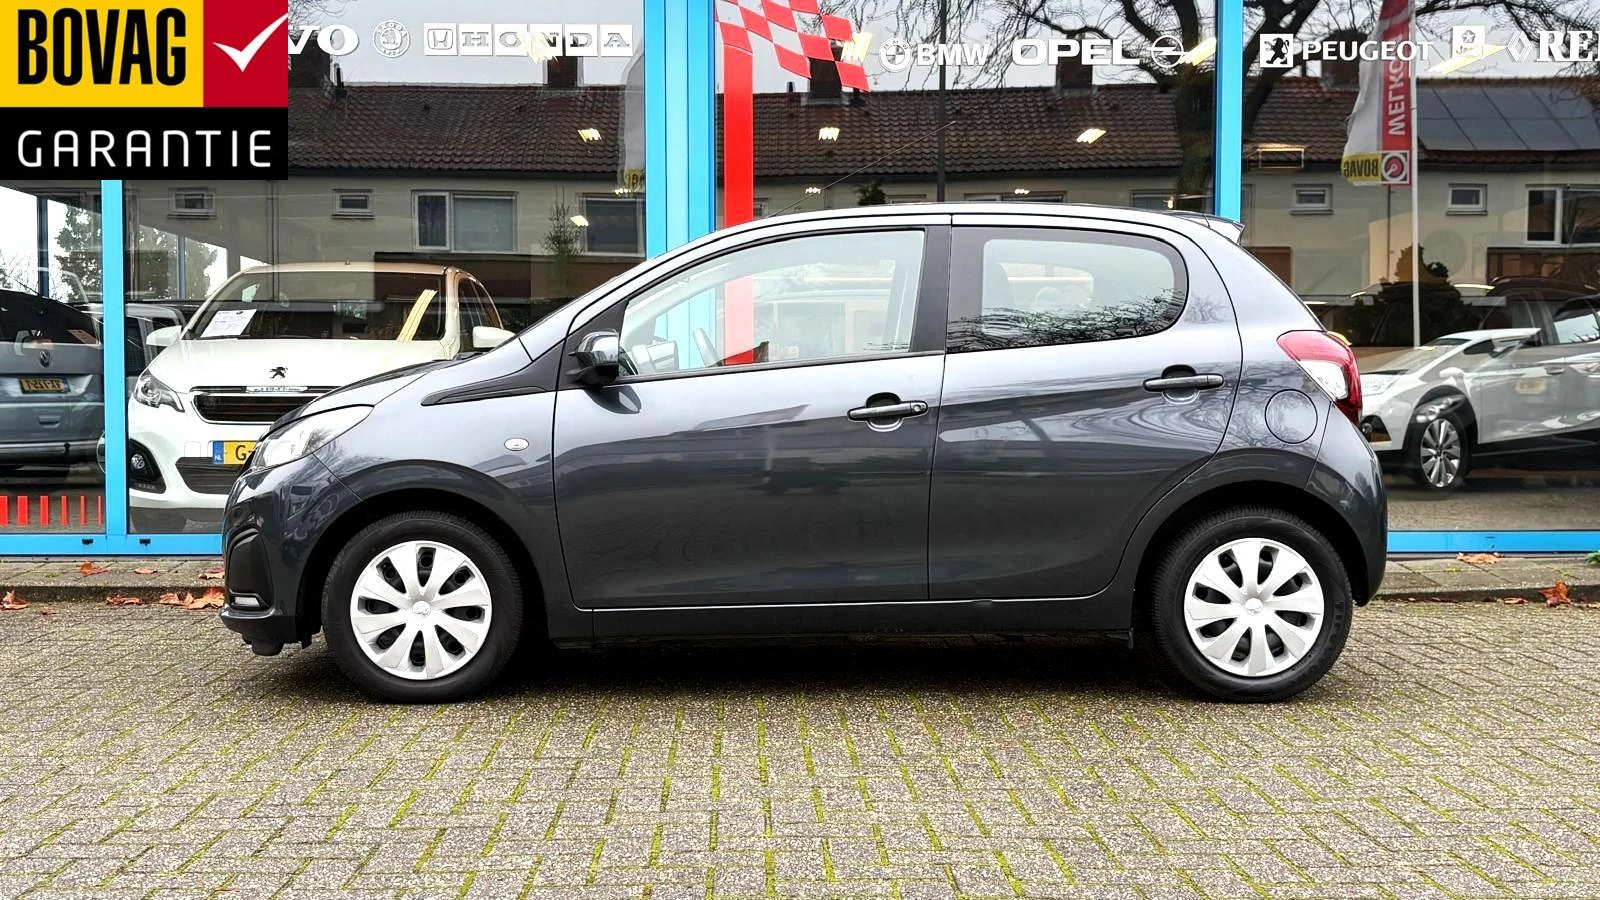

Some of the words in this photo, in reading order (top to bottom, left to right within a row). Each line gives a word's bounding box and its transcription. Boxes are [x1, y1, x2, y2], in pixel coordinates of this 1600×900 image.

[917, 43, 990, 66] BMW
[1012, 38, 1140, 66] OPEL
[1302, 40, 1434, 61] PEUGEOT
[1536, 30, 1600, 62] RE
